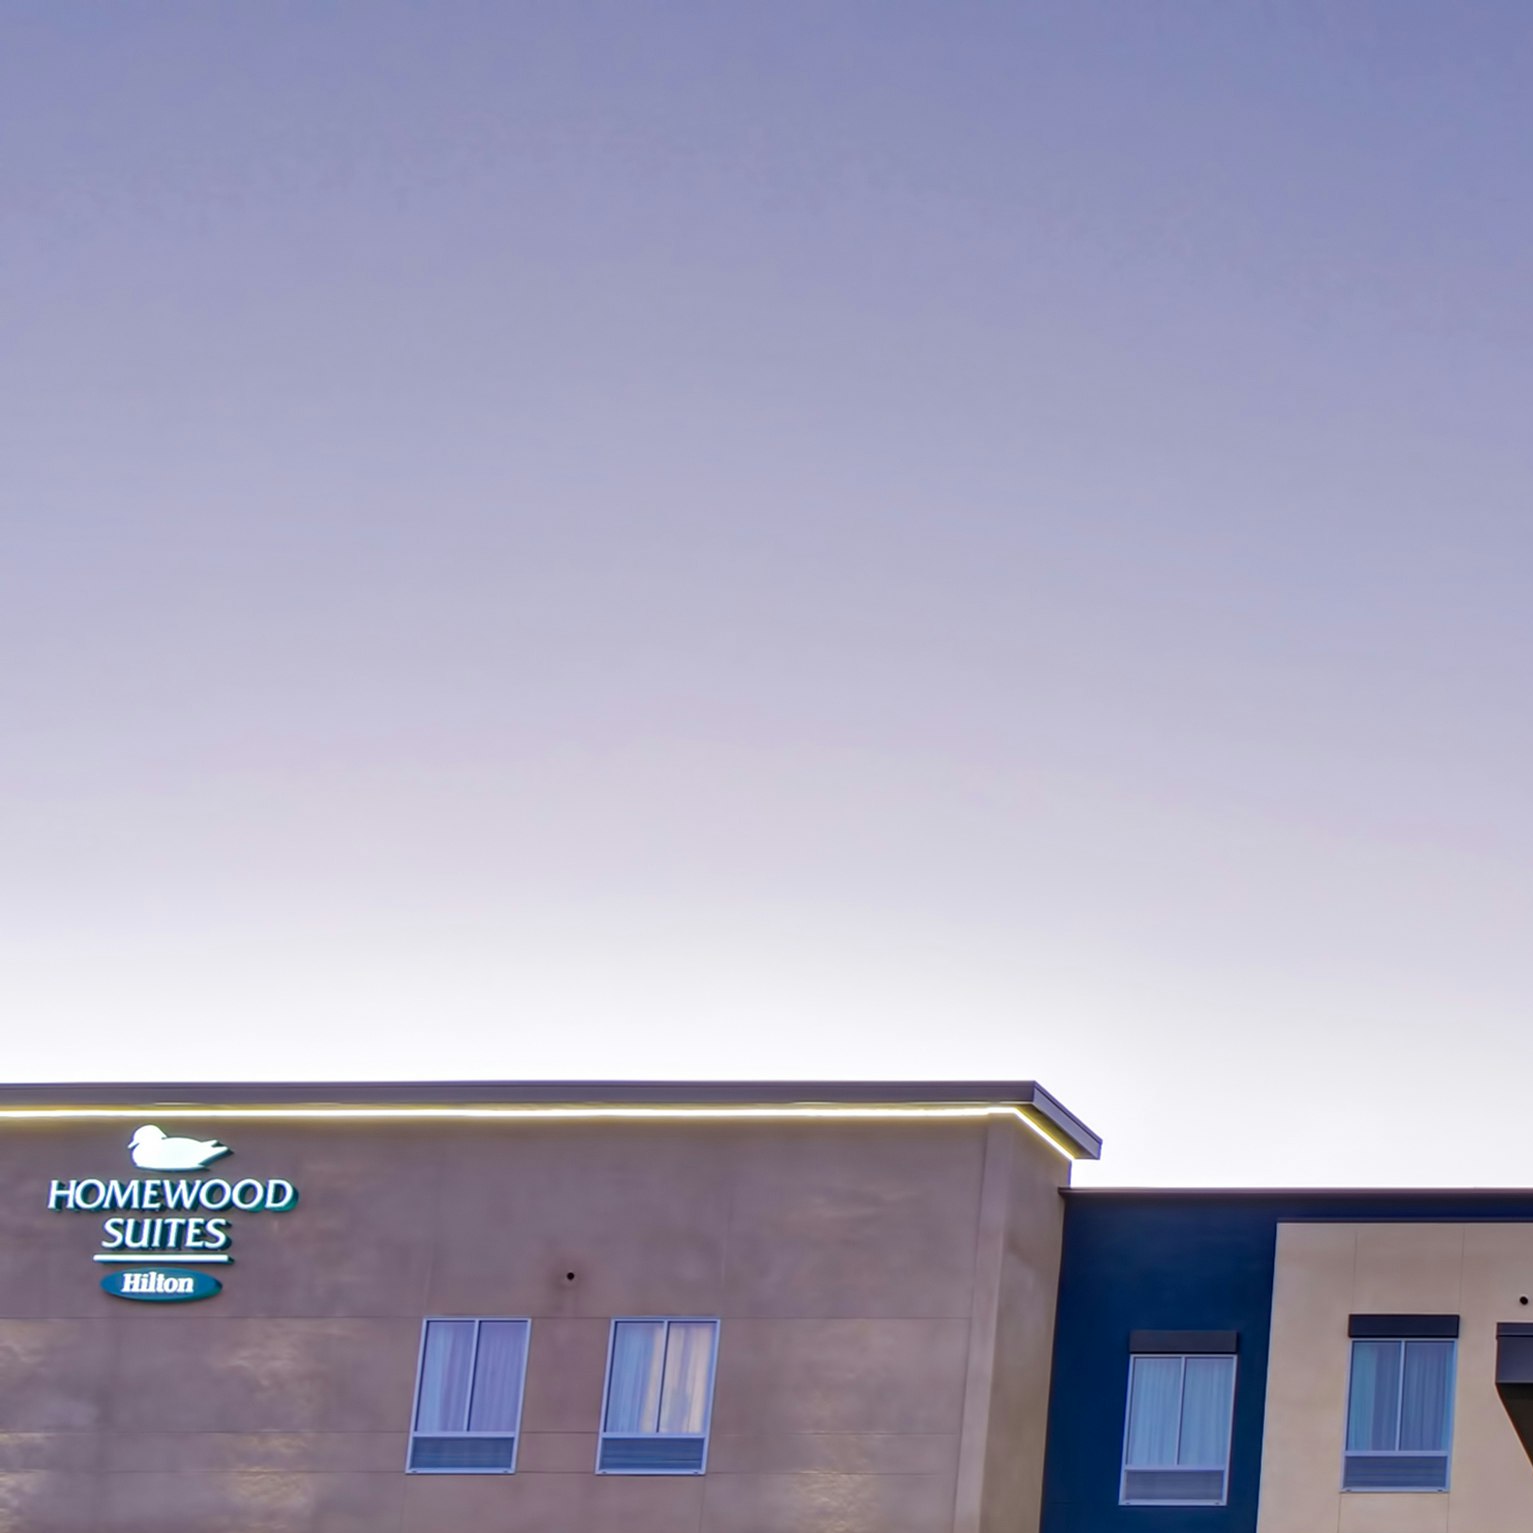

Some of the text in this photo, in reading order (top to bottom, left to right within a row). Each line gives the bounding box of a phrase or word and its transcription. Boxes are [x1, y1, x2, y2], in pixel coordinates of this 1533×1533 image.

[47, 1178, 298, 1212] HOMEWOOD
[101, 1217, 232, 1250] SUITES
[120, 1271, 194, 1293] Hilton
